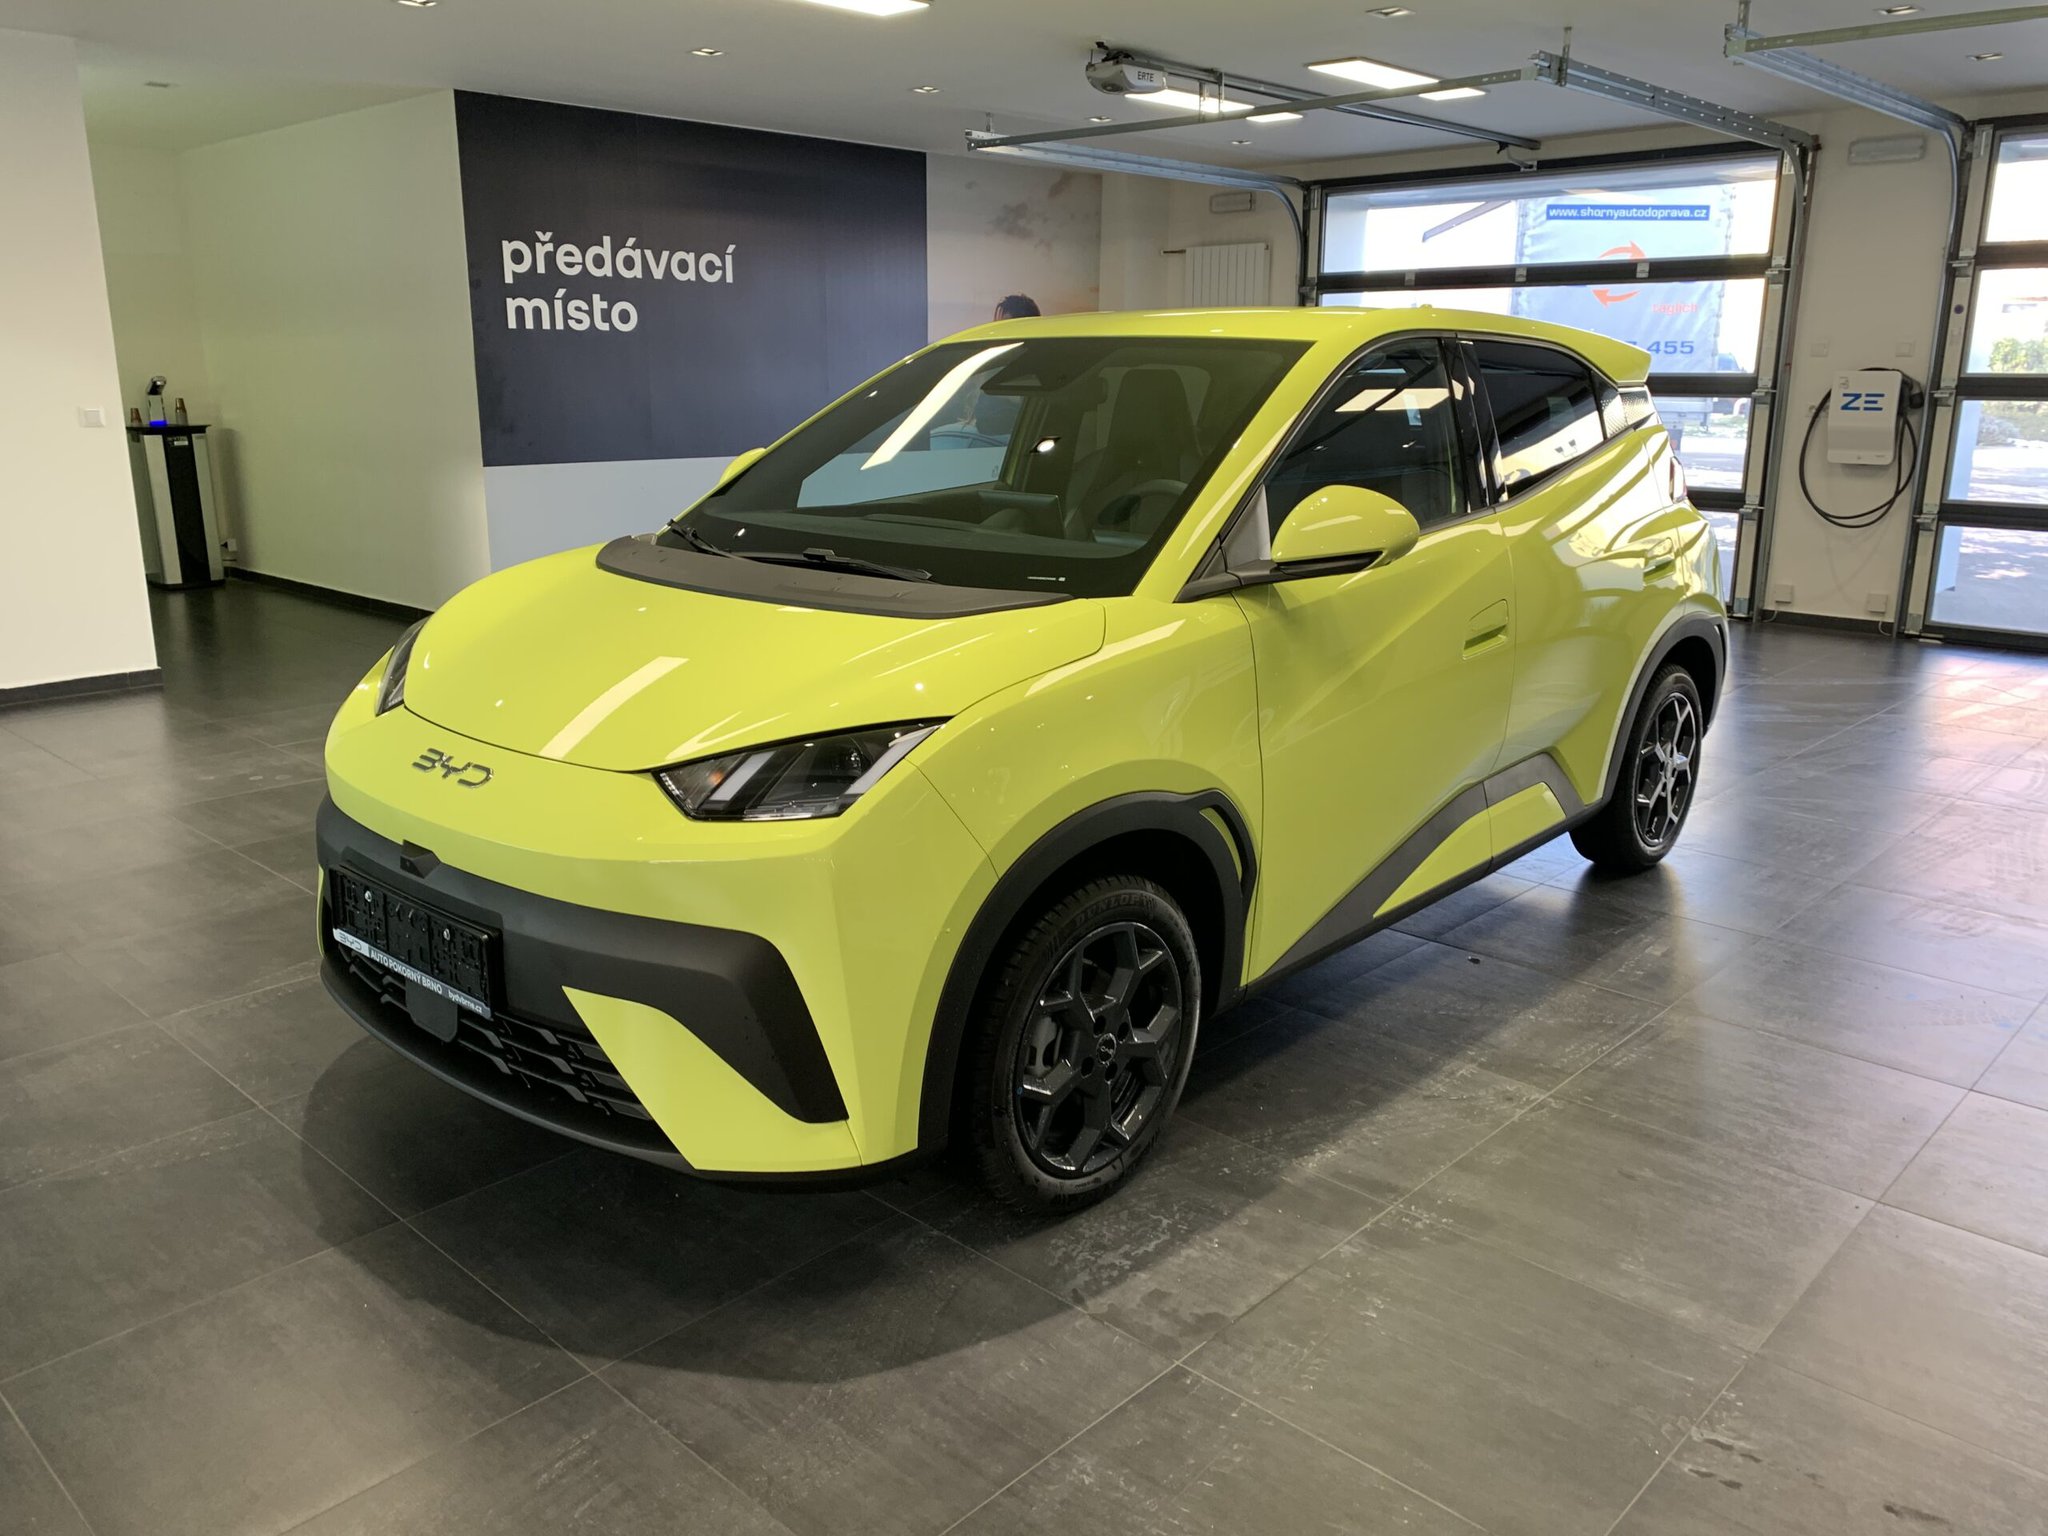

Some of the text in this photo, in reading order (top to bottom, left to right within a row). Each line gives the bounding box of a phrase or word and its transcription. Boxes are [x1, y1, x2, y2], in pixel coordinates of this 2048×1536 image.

[1137, 70, 1154, 82] ERTE
[1549, 207, 1707, 219] www.shornyautodoprava.cz
[501, 230, 736, 284] předávací
[505, 288, 638, 332] místo
[1647, 341, 1694, 354] 455
[1840, 393, 1885, 411] ZE
[412, 747, 493, 788] BYD
[339, 932, 362, 951] BYD
[370, 949, 443, 995] AUTO POKORNÝ BRNO
